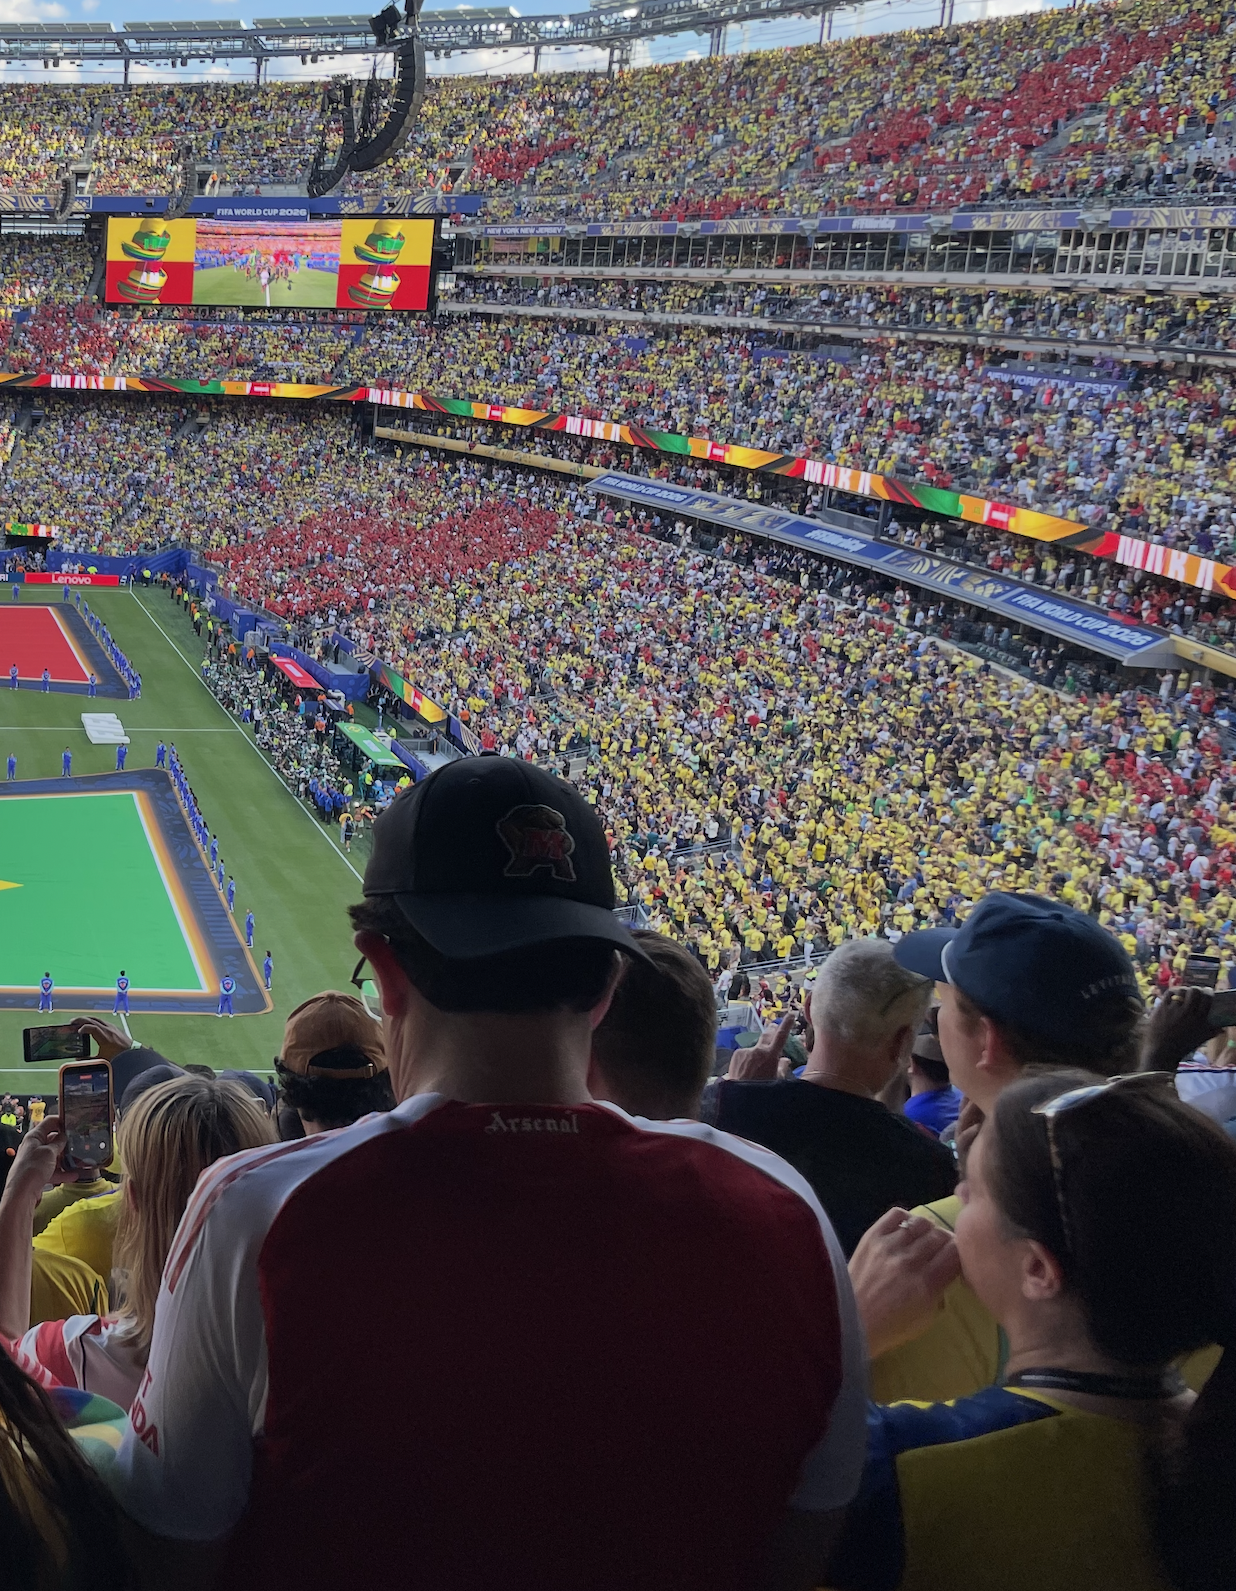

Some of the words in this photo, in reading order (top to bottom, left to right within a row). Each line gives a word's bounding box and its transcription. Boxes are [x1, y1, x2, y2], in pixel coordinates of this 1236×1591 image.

[233, 208, 261, 216] WORLD
[262, 208, 279, 216] CUP
[279, 208, 308, 216] 2026
[487, 227, 502, 235] NEW
[502, 227, 520, 235] YORK
[536, 226, 563, 234] JERSEY
[1012, 374, 1042, 386] YORK
[601, 477, 616, 486] FIFA
[616, 480, 644, 492] WORLD
[641, 486, 661, 495] CUP
[656, 490, 687, 502] 2026
[51, 574, 92, 585] Lenovo
[1012, 593, 1044, 608] FIFA
[1034, 601, 1079, 622] WORLD
[1075, 616, 1108, 630] CUP
[1097, 624, 1153, 646] 2026
[484, 1111, 579, 1134] Arsenal
